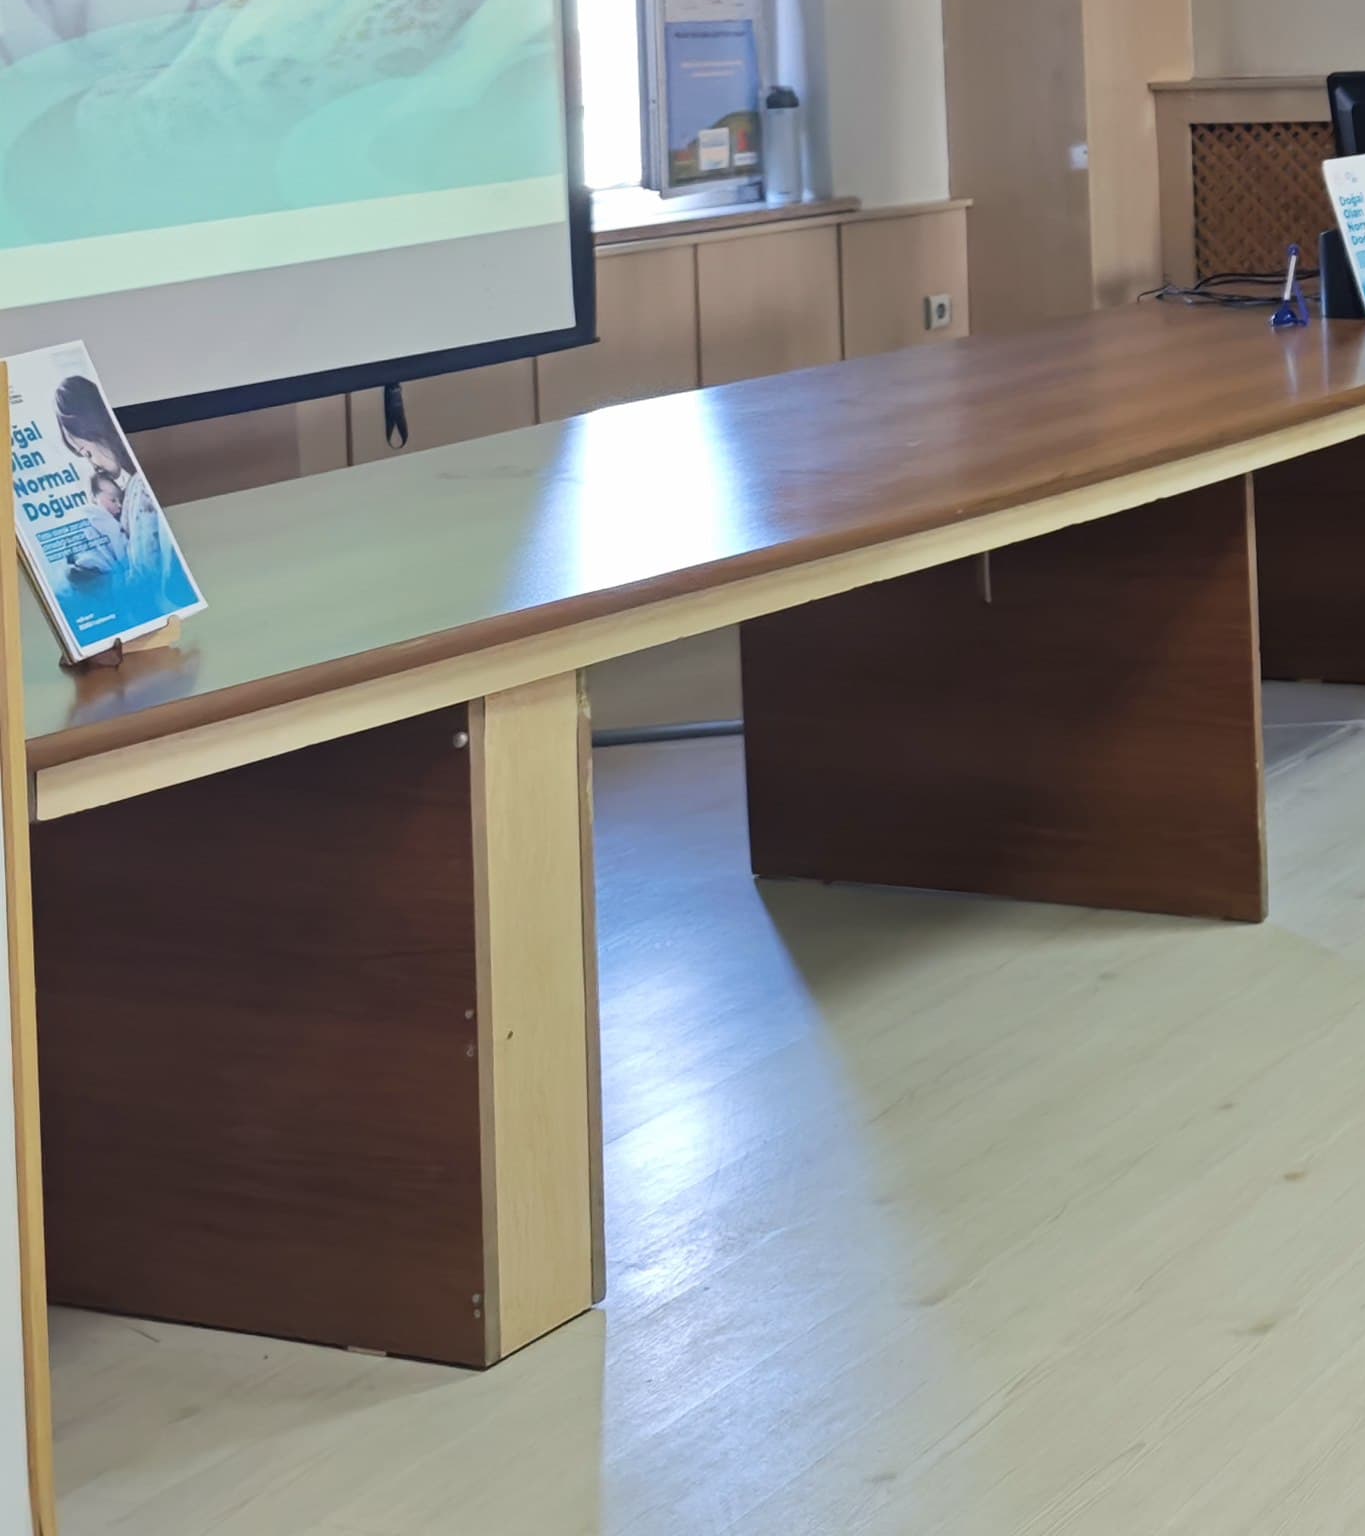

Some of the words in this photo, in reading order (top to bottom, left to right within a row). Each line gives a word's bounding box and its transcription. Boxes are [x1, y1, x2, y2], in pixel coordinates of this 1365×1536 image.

[1339, 192, 1363, 206] Doğal
[14, 462, 80, 498] Normal
[23, 489, 87, 522] Doğum
